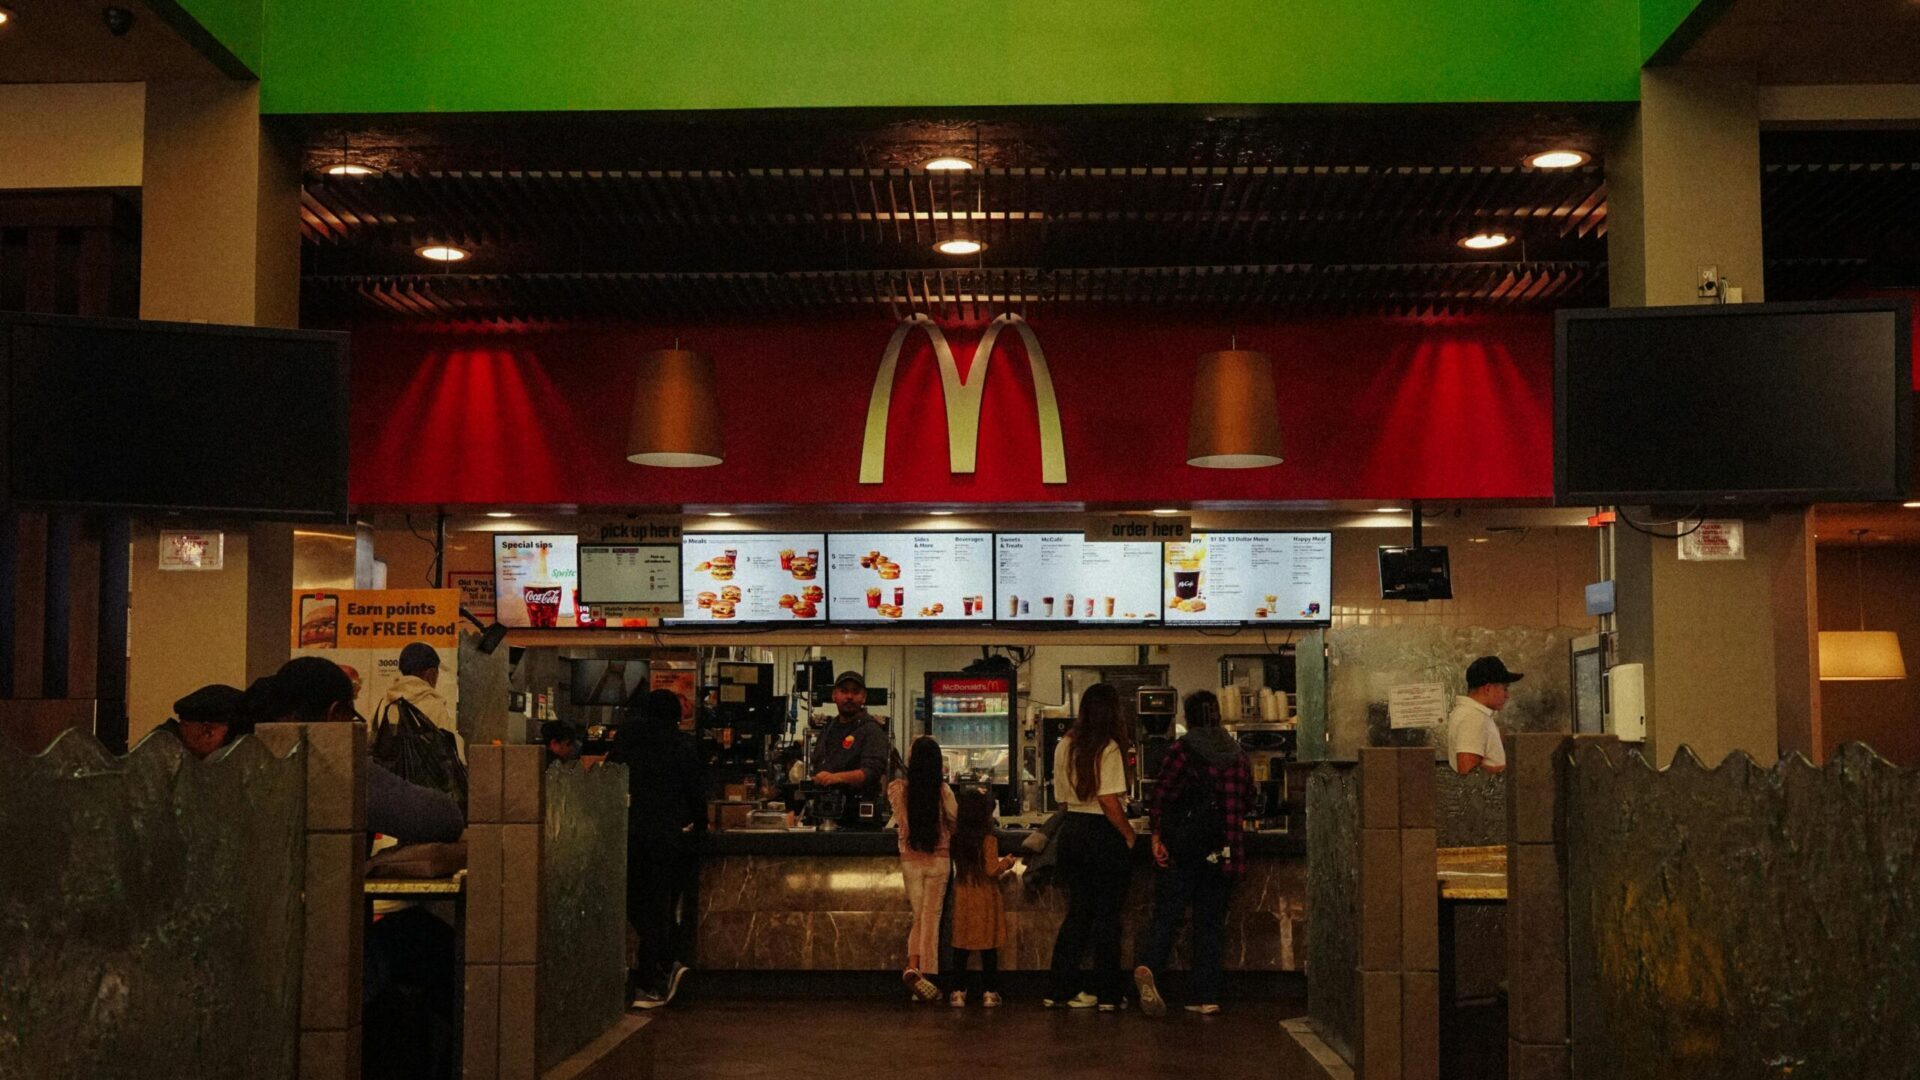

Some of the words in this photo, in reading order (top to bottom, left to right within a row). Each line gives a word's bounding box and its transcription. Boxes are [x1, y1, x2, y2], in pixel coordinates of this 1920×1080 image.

[601, 522, 629, 541] pick
[631, 526, 646, 541] up
[649, 522, 680, 538] here
[1112, 522, 1148, 538] order
[1152, 521, 1184, 537] here
[502, 540, 534, 551] Special
[535, 540, 553, 551] sips
[1292, 536, 1311, 544] Happy
[551, 568, 577, 579] Sprite
[347, 603, 383, 616] Earn
[386, 602, 436, 618] points
[346, 622, 370, 636] for
[373, 622, 417, 636] FREE
[420, 622, 456, 636] food
[378, 658, 399, 667] 3000
[942, 683, 987, 691] McDonald's
